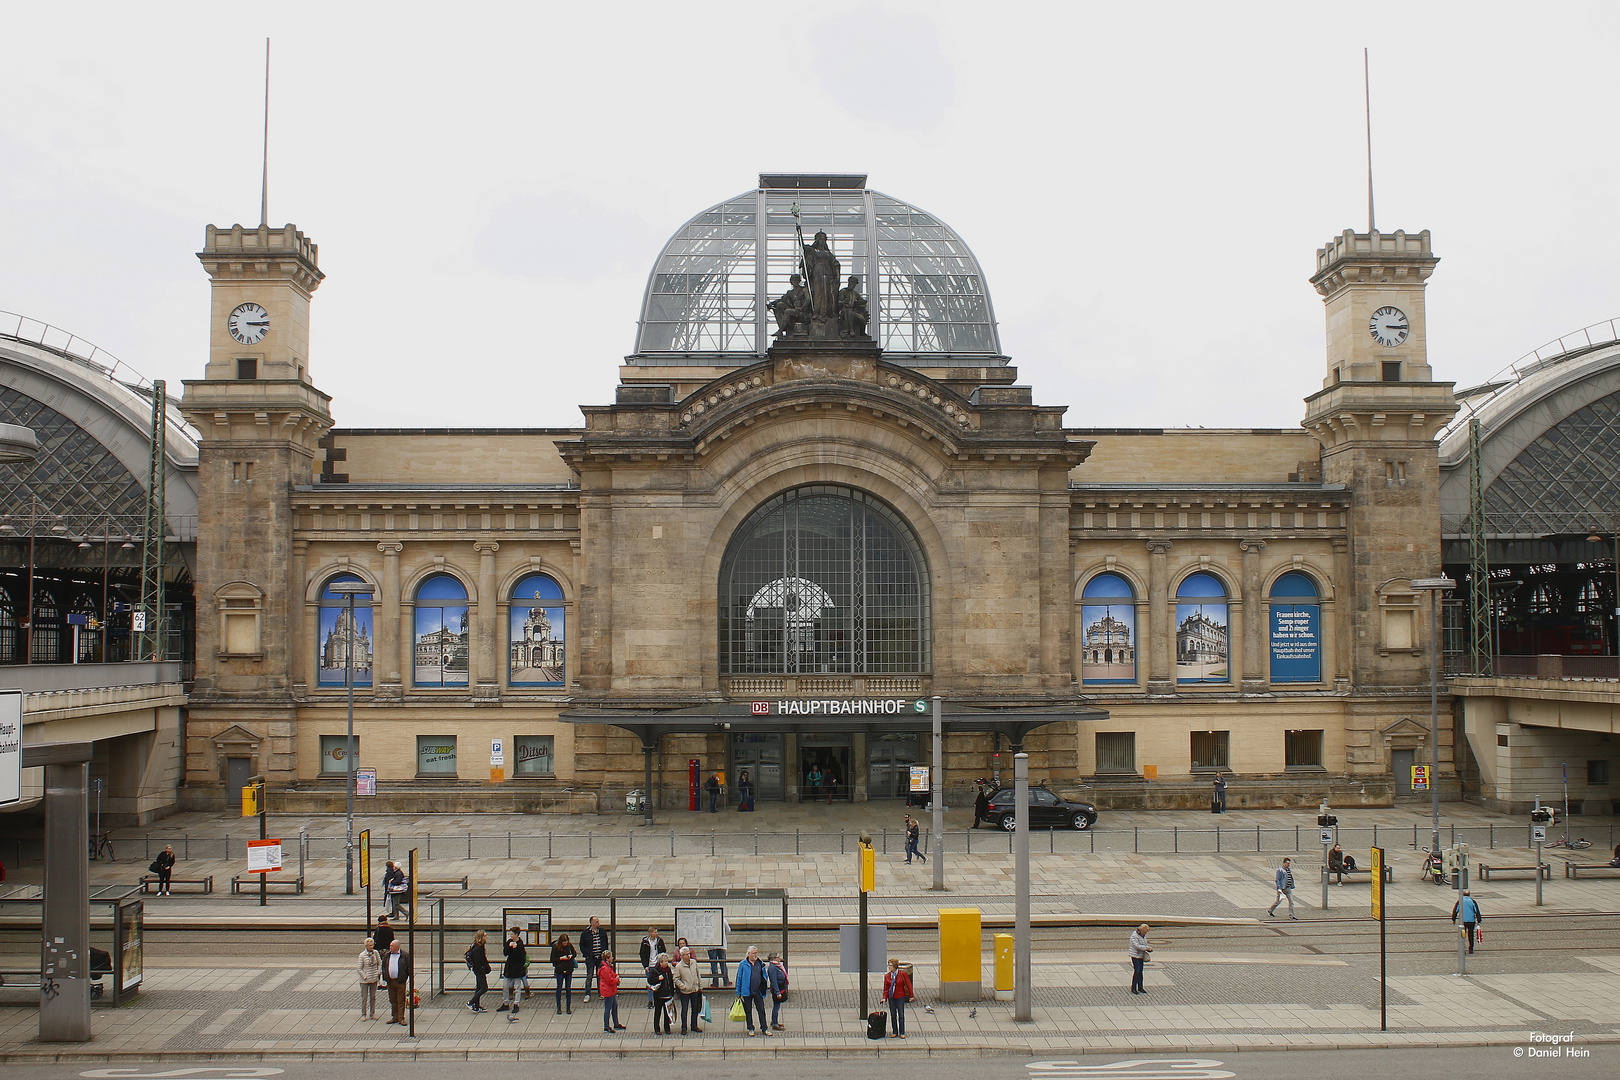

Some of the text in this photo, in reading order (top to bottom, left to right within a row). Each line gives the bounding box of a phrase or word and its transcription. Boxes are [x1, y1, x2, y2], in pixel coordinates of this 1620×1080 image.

[752, 702, 769, 713] DB
[778, 700, 906, 715] HAUPTBAHNHOF
[914, 700, 926, 713] S
[420, 745, 456, 755] SUBWAY
[519, 744, 549, 760] Ditsch
